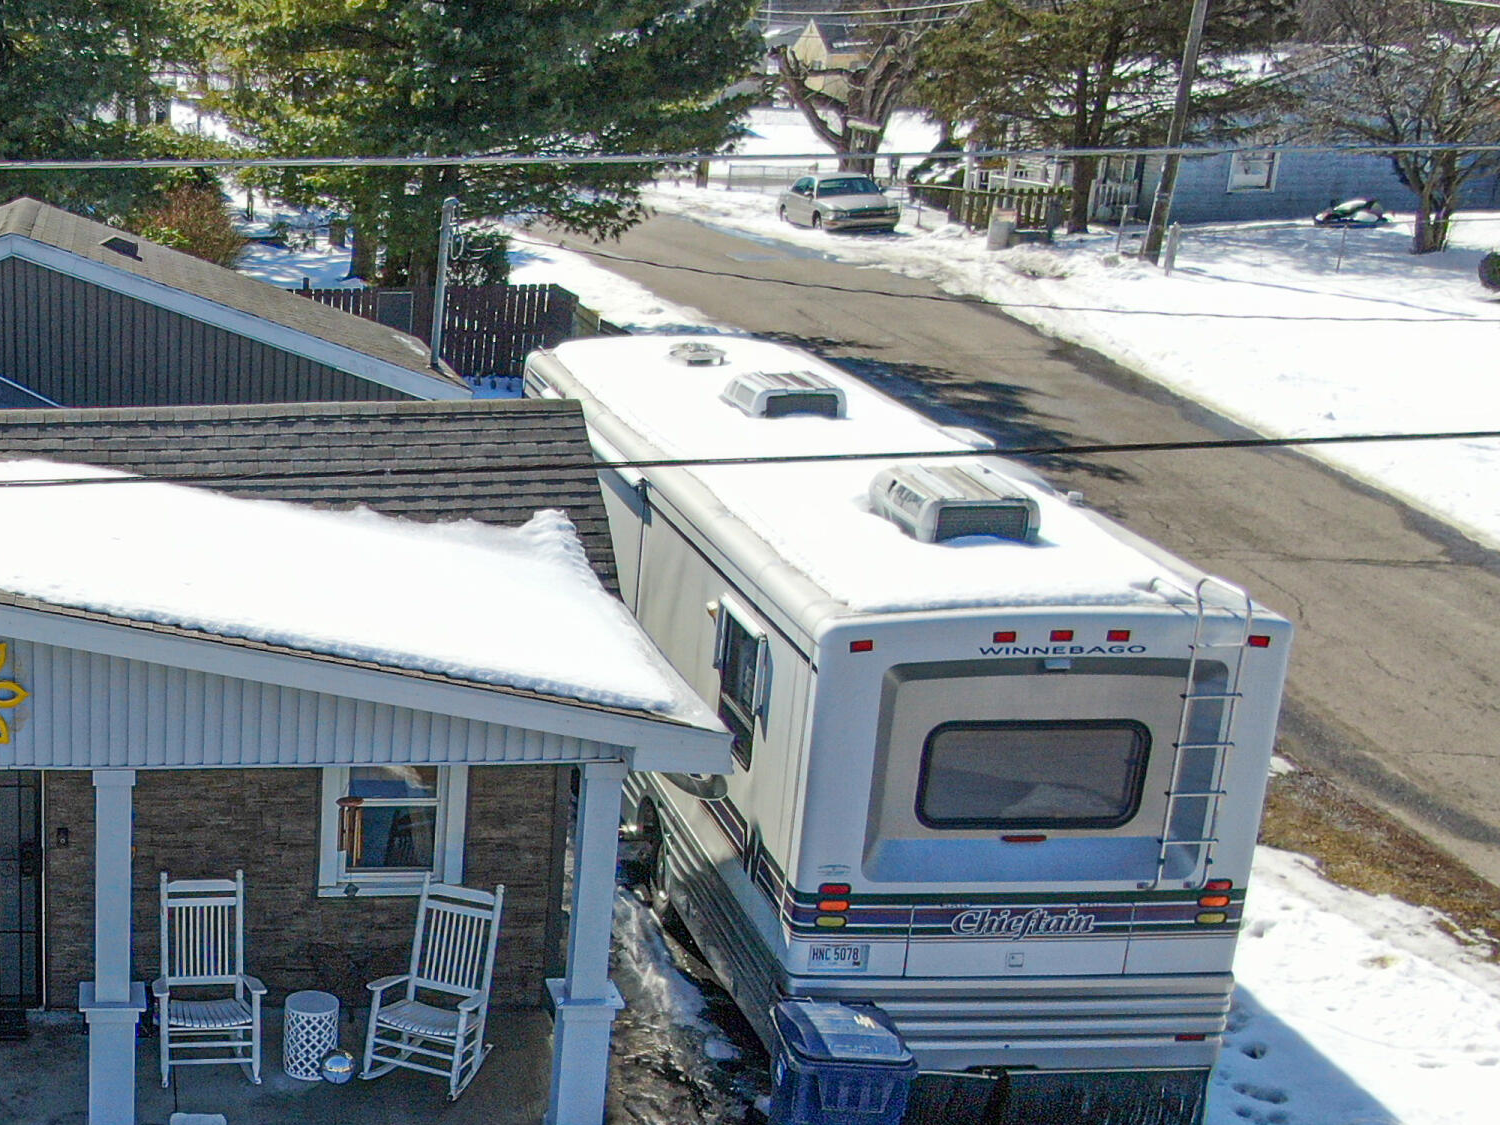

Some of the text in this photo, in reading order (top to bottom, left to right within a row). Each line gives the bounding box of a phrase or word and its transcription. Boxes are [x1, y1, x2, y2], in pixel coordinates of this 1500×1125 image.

[979, 645, 1146, 656] WINNEBAGO
[951, 907, 1095, 940] Chieftain
[812, 947, 859, 961] HNC 5078
